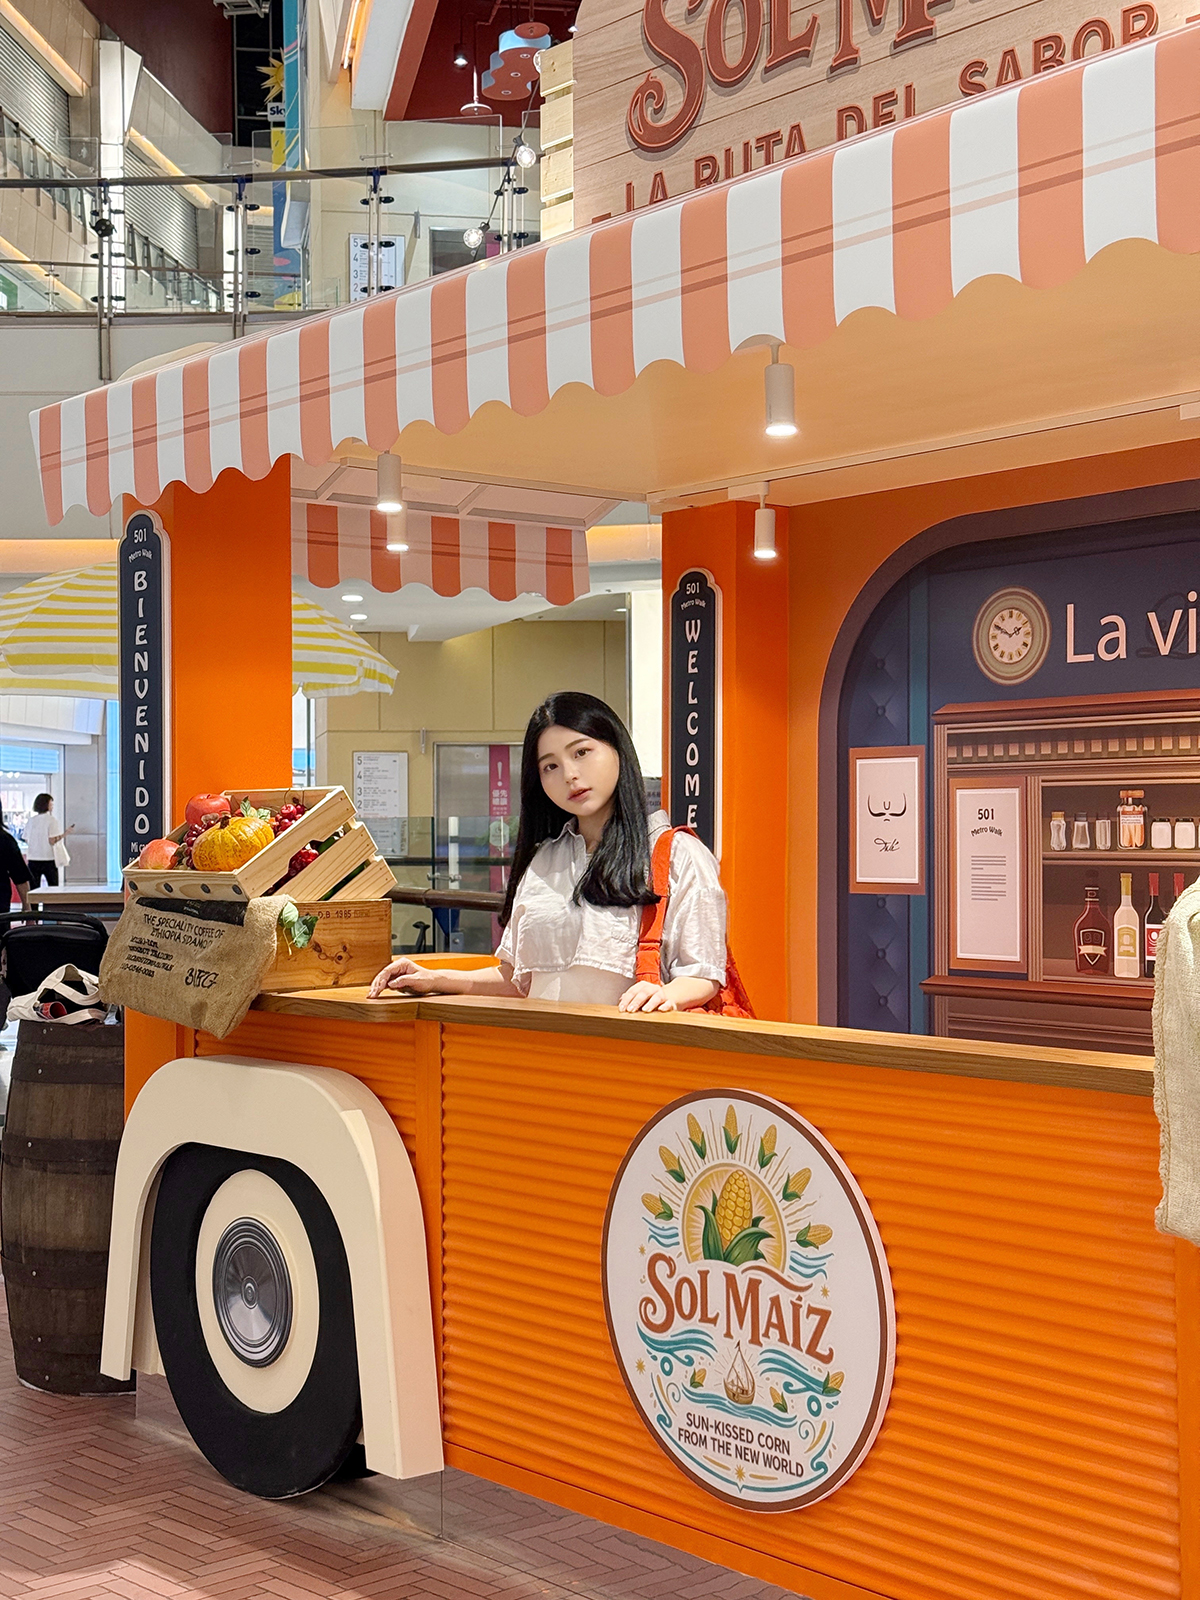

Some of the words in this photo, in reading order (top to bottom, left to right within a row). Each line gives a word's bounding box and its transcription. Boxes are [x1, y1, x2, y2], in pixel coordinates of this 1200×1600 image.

[353, 238, 359, 248] 5
[353, 253, 359, 262] 4
[353, 269, 359, 279] 3
[353, 283, 359, 292] 2
[133, 528, 147, 543] 501
[686, 582, 700, 595] 501
[1066, 603, 1127, 663] La
[133, 570, 151, 835] BIENVENIDO
[684, 619, 701, 829] WELCOME
[357, 756, 363, 766] 5
[357, 771, 363, 780] 4
[357, 787, 363, 796] 3
[357, 800, 363, 809] 2
[977, 808, 995, 820] 501
[970, 826, 989, 837] Metro
[988, 825, 1003, 837] Walk
[143, 913, 155, 926] THE
[193, 925, 215, 939] COFFEE
[214, 929, 226, 939] OF
[639, 1253, 720, 1334] SOL
[686, 1412, 754, 1444] SUN-KISSED
[757, 1433, 791, 1456] CORN
[678, 1427, 708, 1450] FROM
[710, 1436, 732, 1457] THE
[735, 1444, 760, 1465] NEW
[762, 1452, 804, 1478] WORLD
